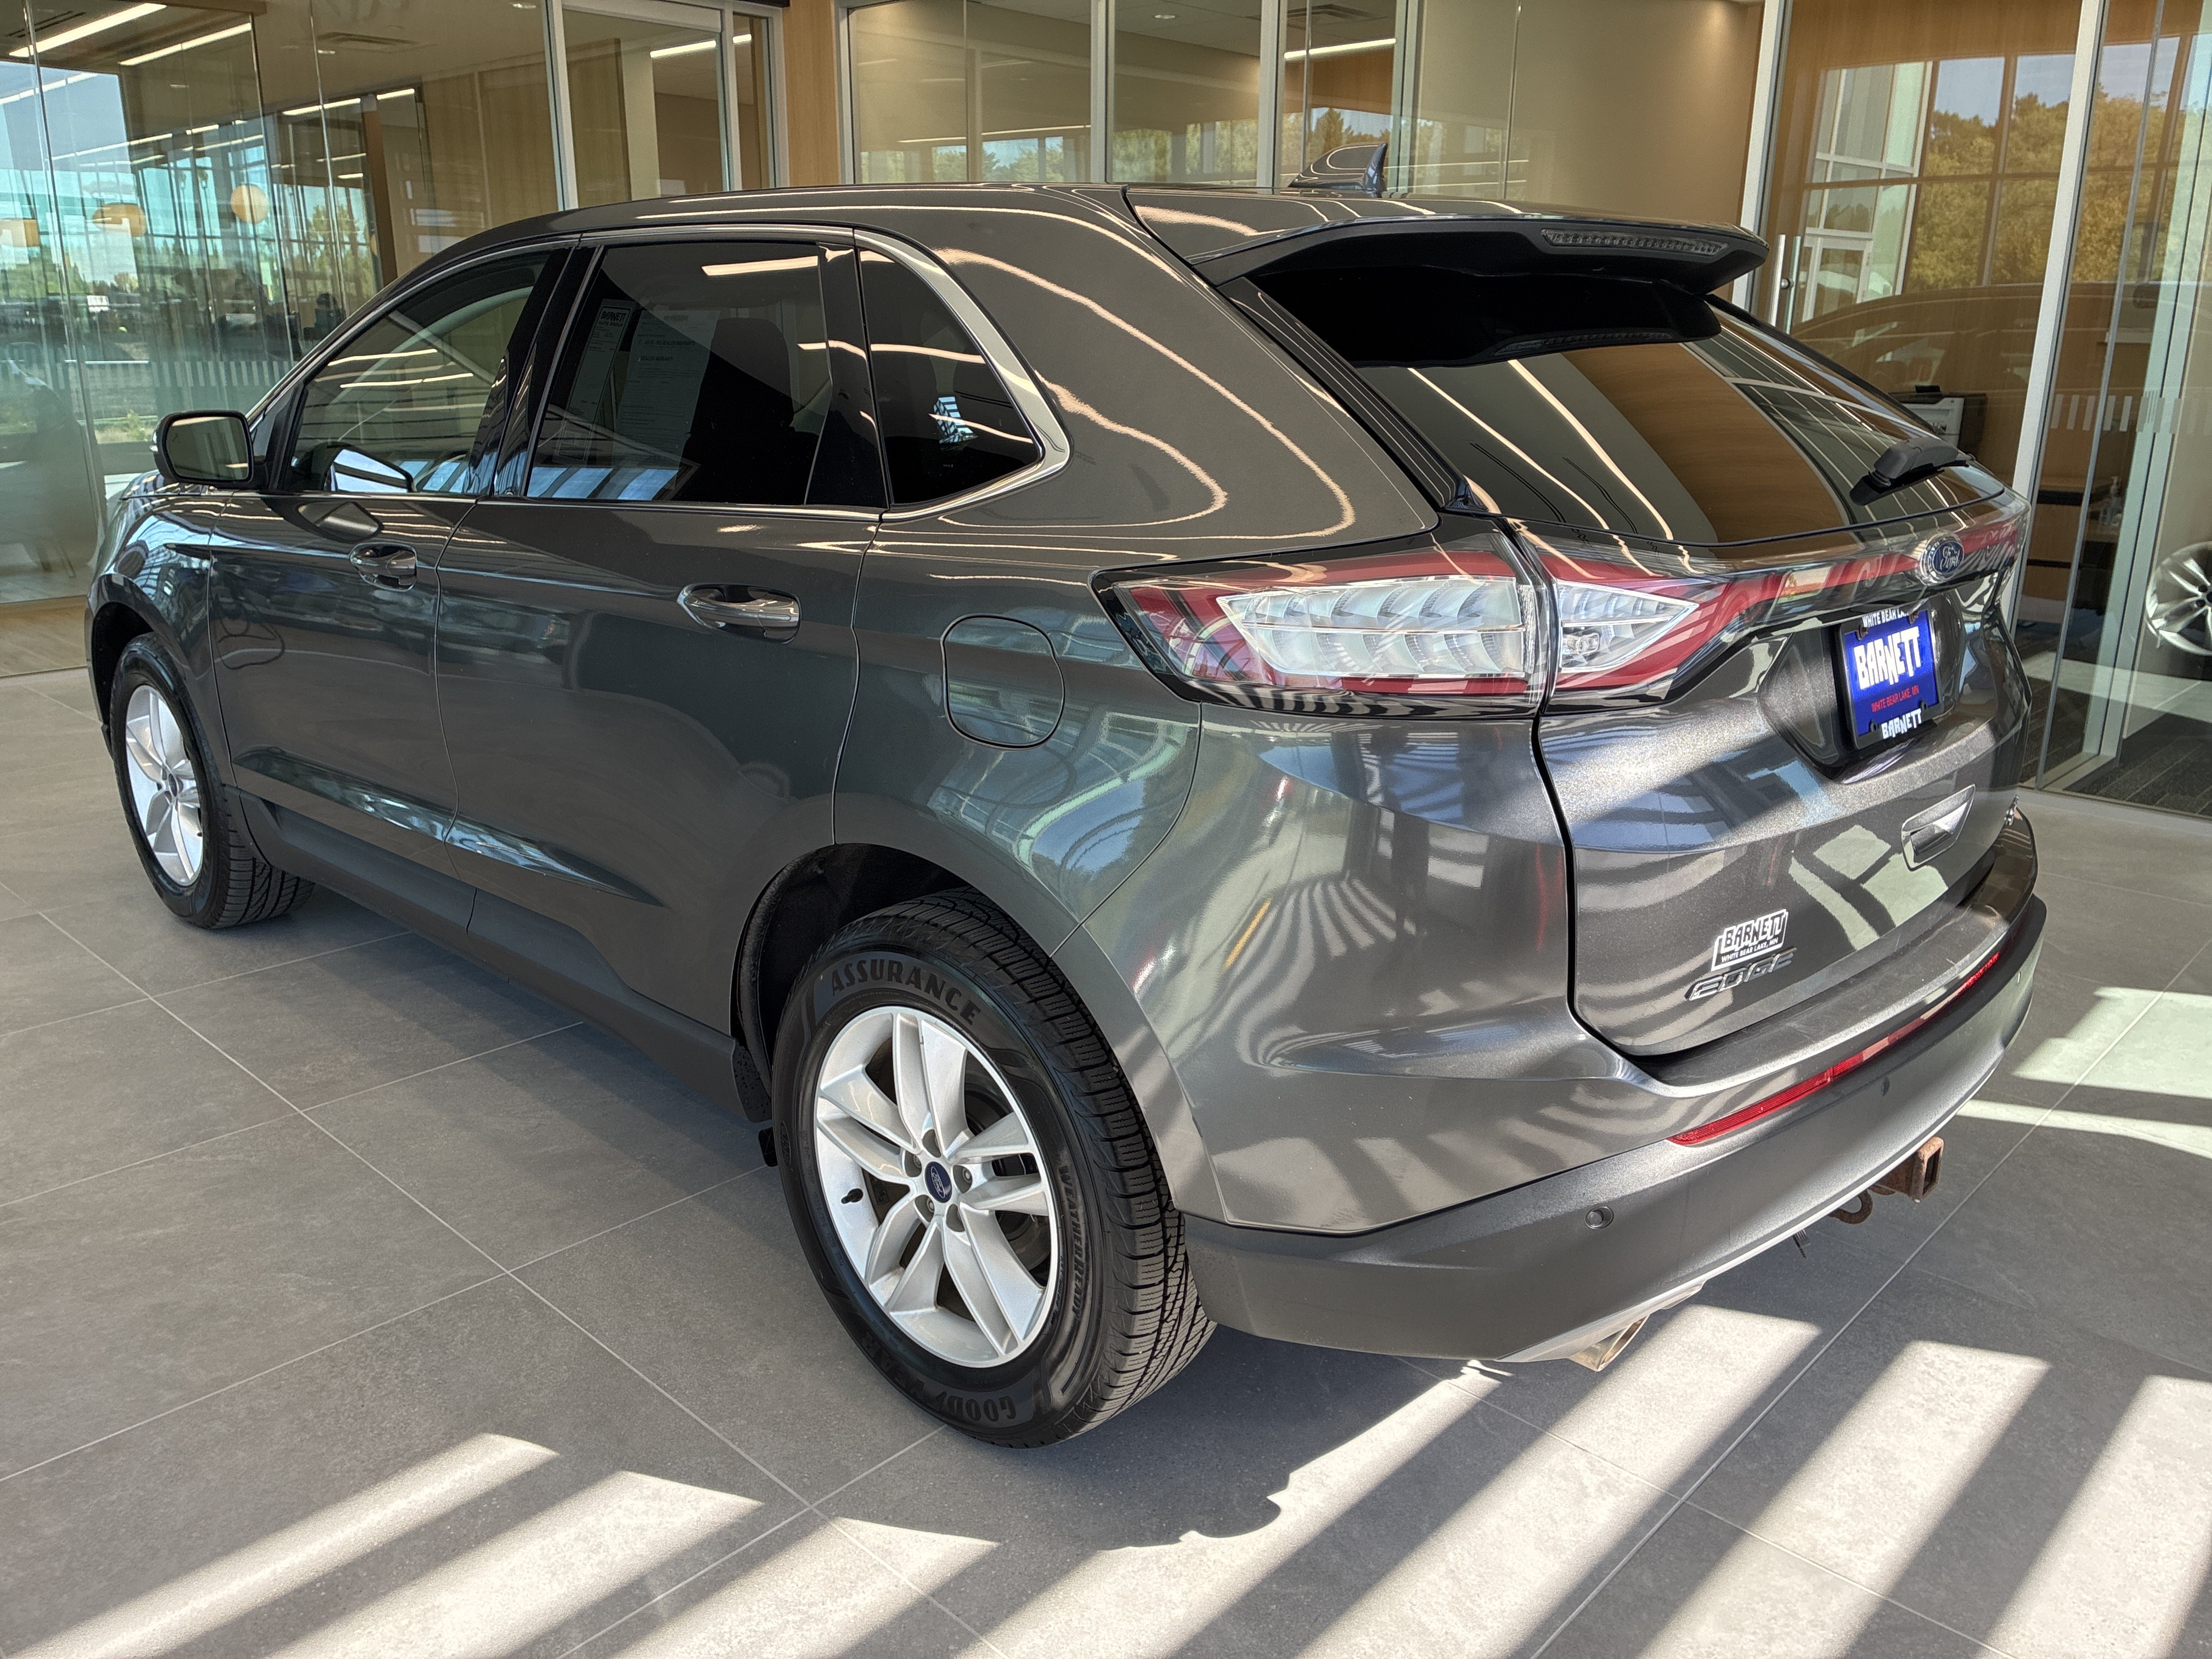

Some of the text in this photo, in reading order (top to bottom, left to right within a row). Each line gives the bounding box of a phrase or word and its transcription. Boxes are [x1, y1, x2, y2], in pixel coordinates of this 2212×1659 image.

[1862, 612, 1881, 628] WHITE
[1881, 608, 1897, 623] BEAR
[1853, 626, 1921, 690] BARNETT
[1871, 698, 1886, 712] WHITE
[1886, 693, 1899, 707] BEAR
[1881, 708, 1922, 740] BARNETT
[1724, 913, 1784, 948] BARNETT
[1722, 952, 1739, 963] WHITE
[1739, 947, 1753, 956] BEAR
[1769, 937, 1779, 946] MN
[1685, 947, 1797, 1001] EDGE
[832, 959, 981, 1025] ASSURANCE
[861, 1331, 1018, 1423] GOODYEAR
